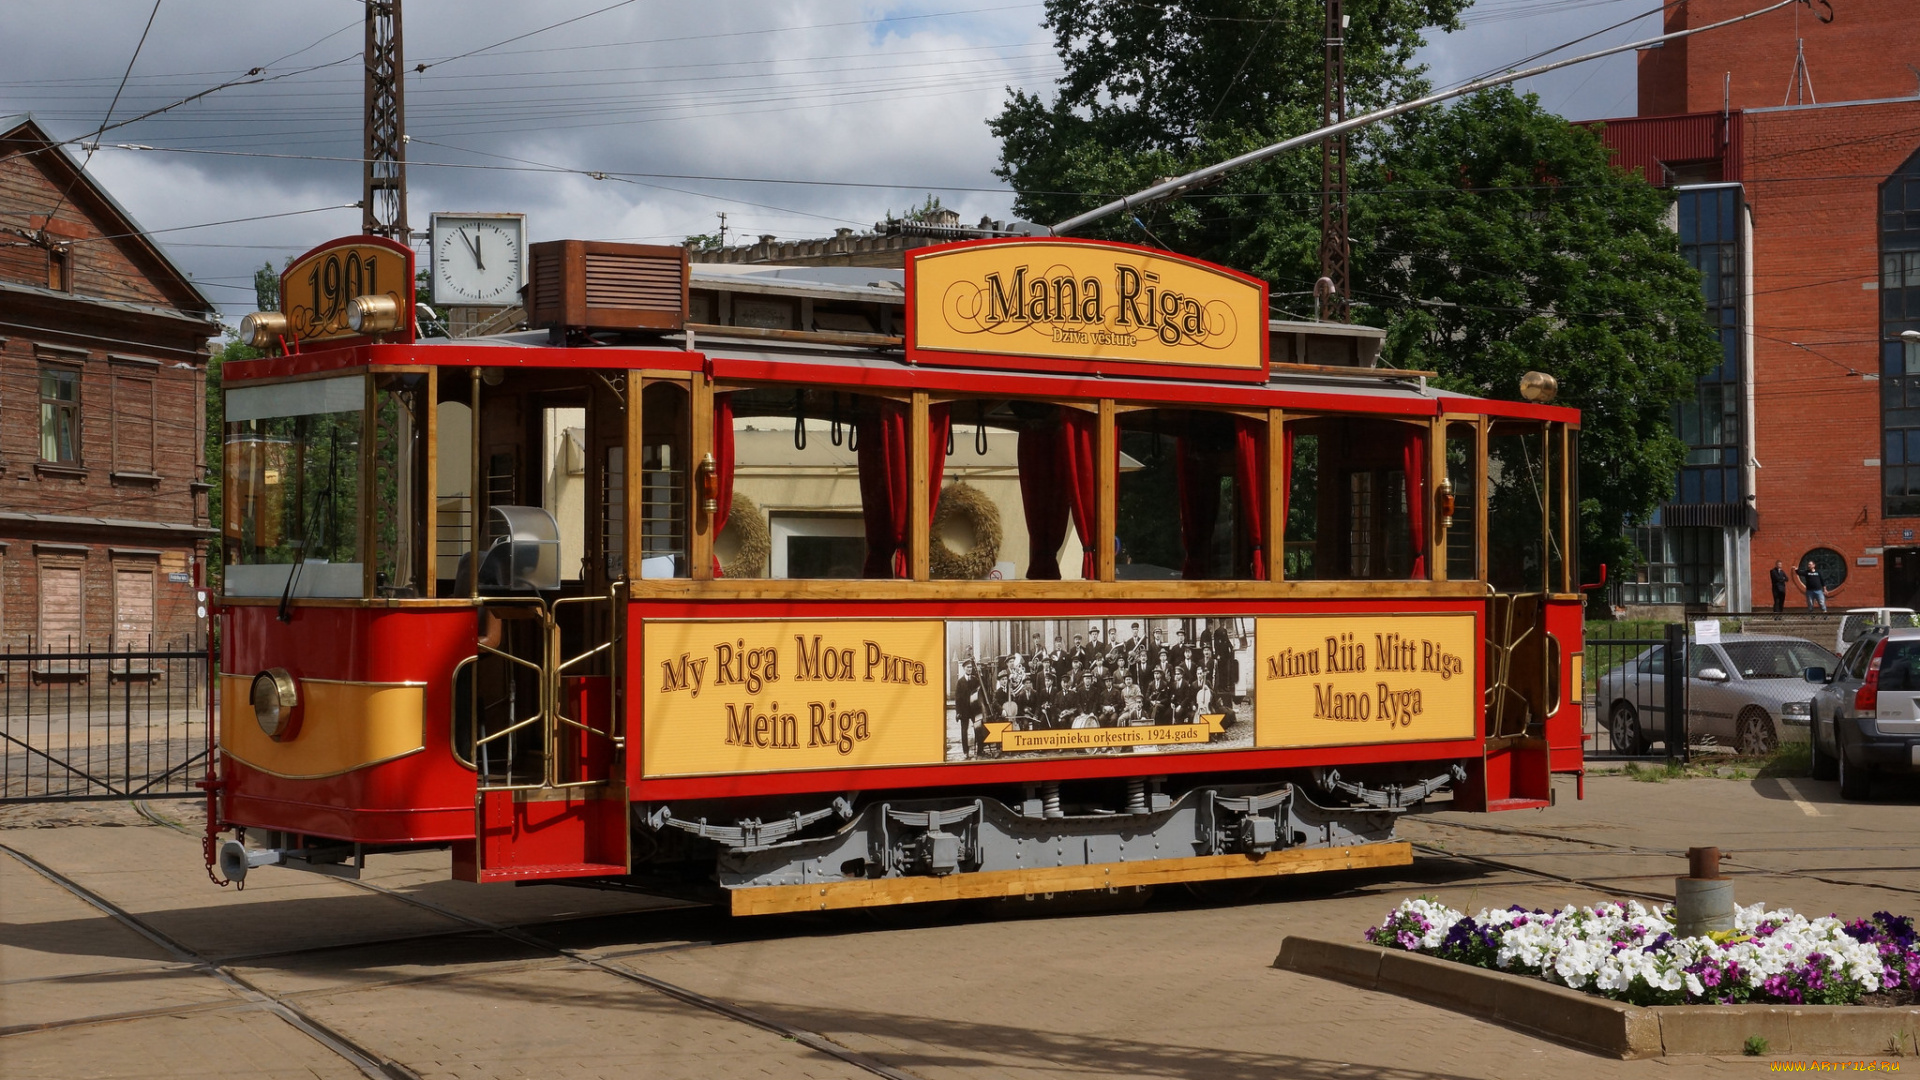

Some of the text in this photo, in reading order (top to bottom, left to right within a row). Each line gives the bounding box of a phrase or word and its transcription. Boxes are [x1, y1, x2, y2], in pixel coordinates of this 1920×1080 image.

[308, 250, 377, 327] 1901
[985, 263, 1206, 346] Mana Rīga
[1052, 328, 1137, 347] Dzīva vēsture
[661, 638, 780, 698] My Riga
[794, 634, 928, 685] Моя Рига
[1267, 632, 1367, 680] Minu Riia
[1374, 632, 1463, 680] Mitt Riga
[725, 699, 870, 755] Mein Riga
[1313, 681, 1423, 730] Mano Ryga
[1014, 728, 1198, 747] Tramvajnieku orķestris. 1924.gads
